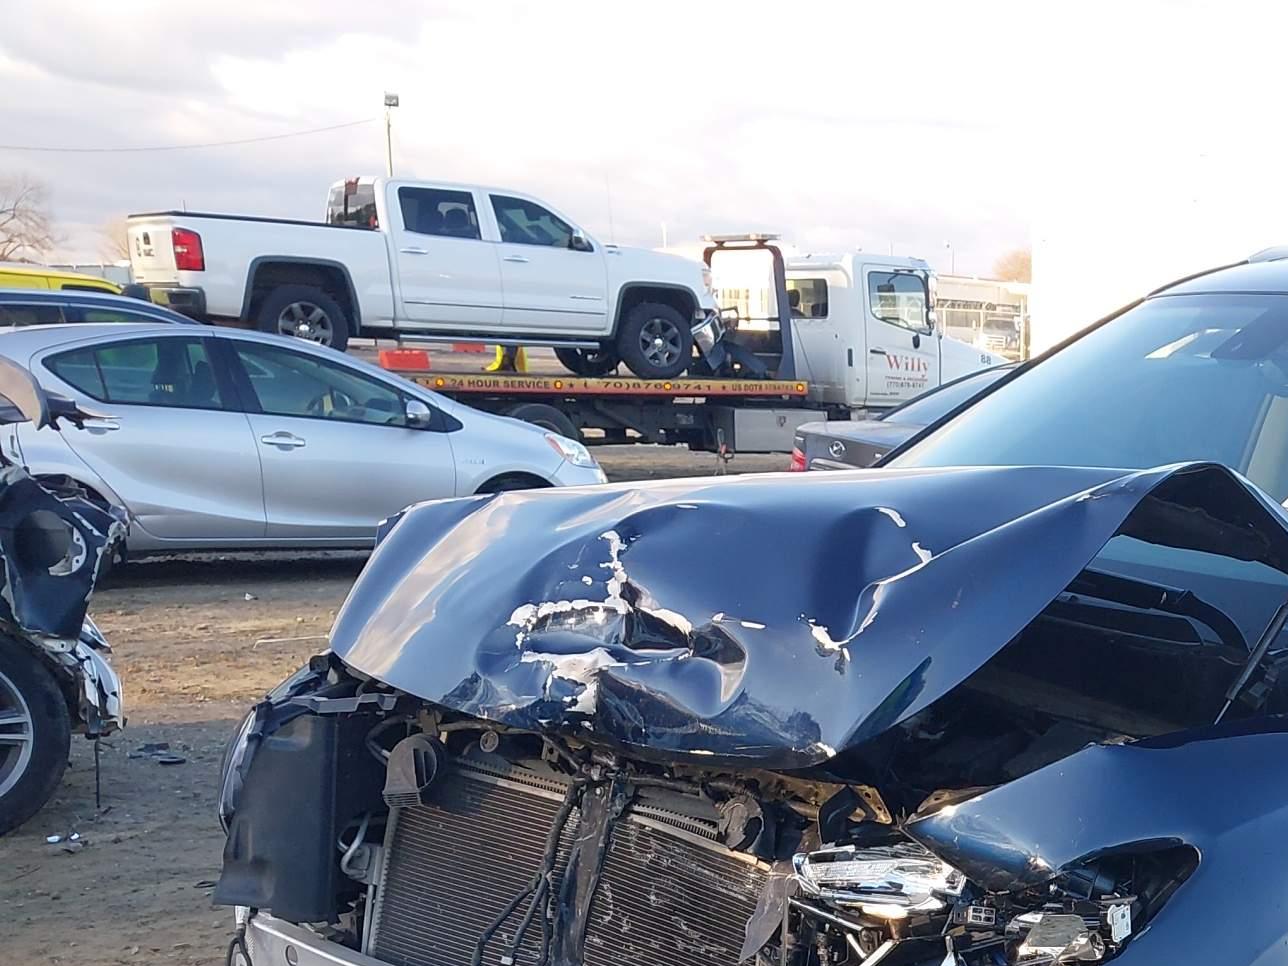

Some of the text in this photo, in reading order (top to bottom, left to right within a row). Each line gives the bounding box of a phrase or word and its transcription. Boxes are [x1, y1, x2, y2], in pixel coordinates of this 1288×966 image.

[886, 354, 928, 377] Willy
[451, 379, 464, 387] 24
[468, 380, 500, 388] HOUR
[503, 380, 551, 389] SERVICE
